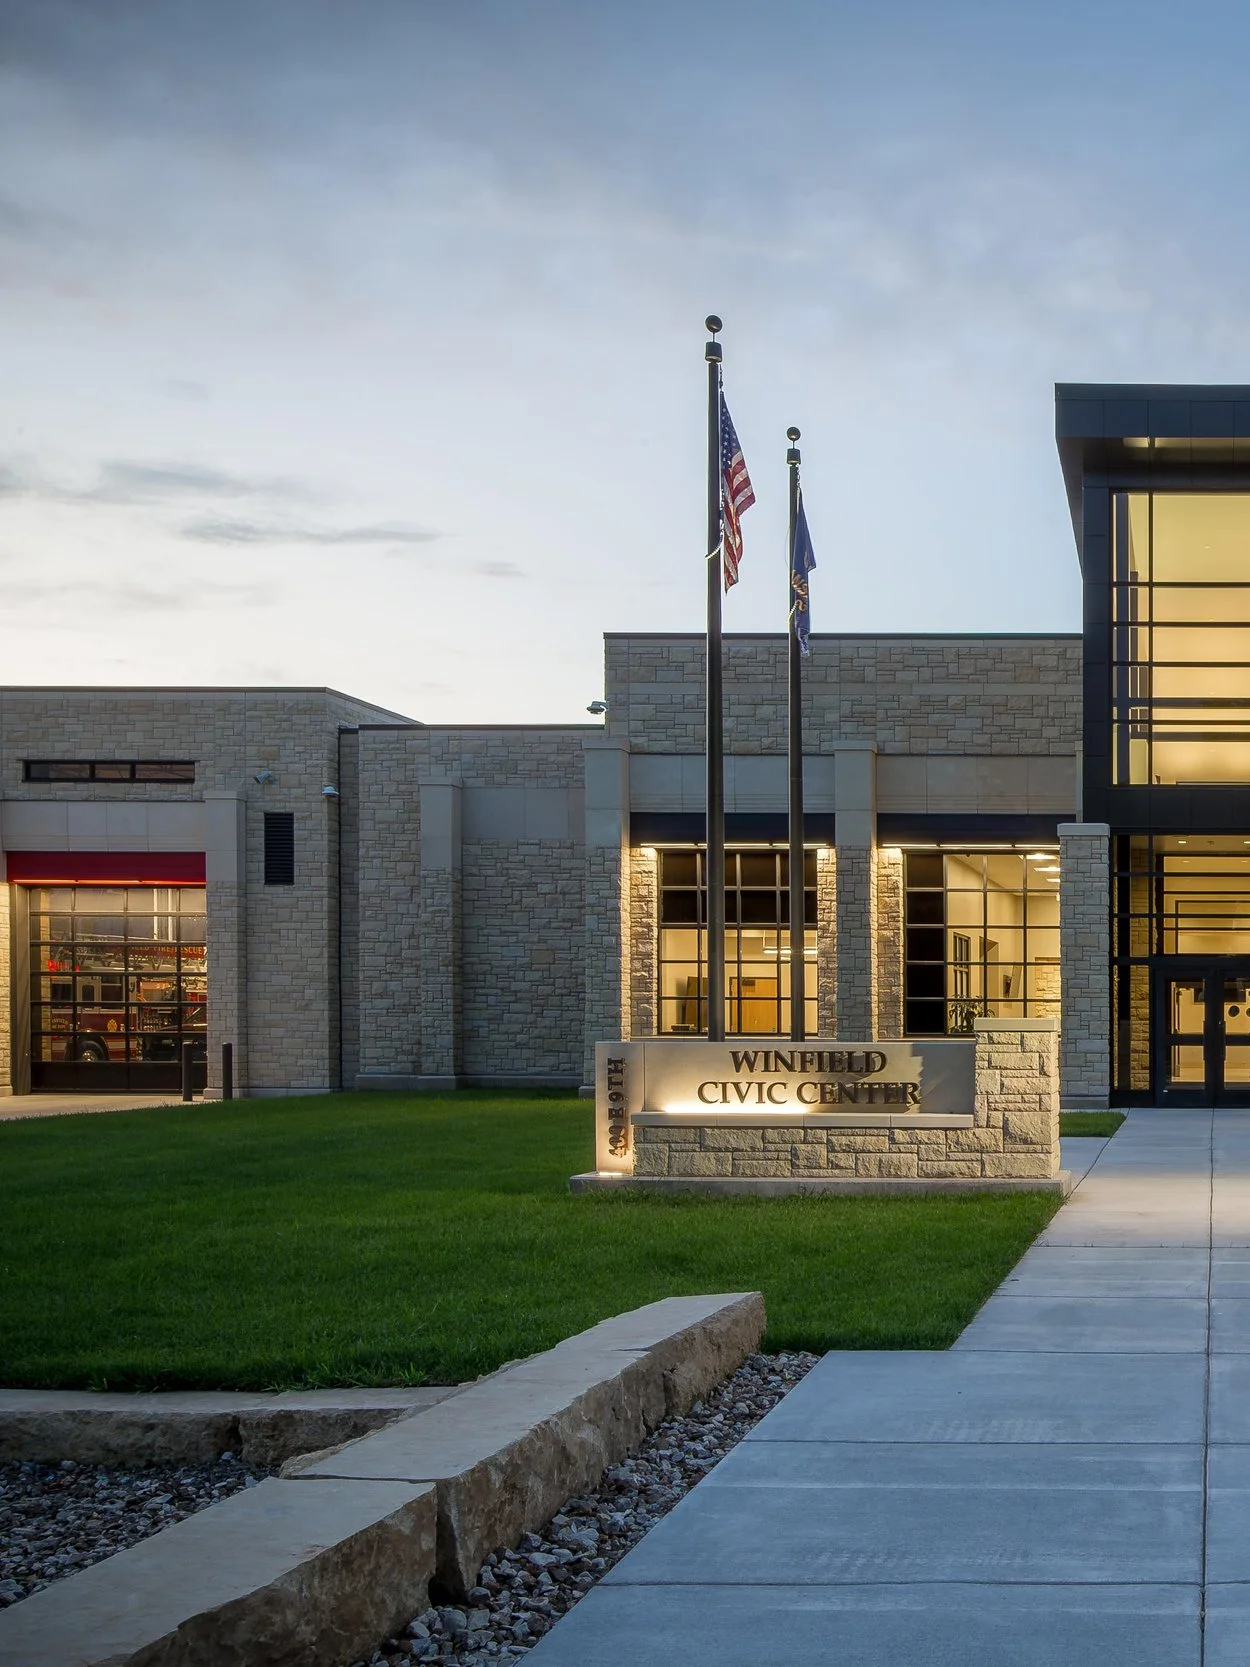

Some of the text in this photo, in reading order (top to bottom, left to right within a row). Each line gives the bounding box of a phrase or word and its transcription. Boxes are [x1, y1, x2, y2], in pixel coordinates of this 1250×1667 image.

[730, 1050, 887, 1074] WINFIELD
[607, 1057, 624, 1102] 9TH
[697, 1081, 922, 1105] CIVIC CENTER
[608, 1108, 624, 1120] E
